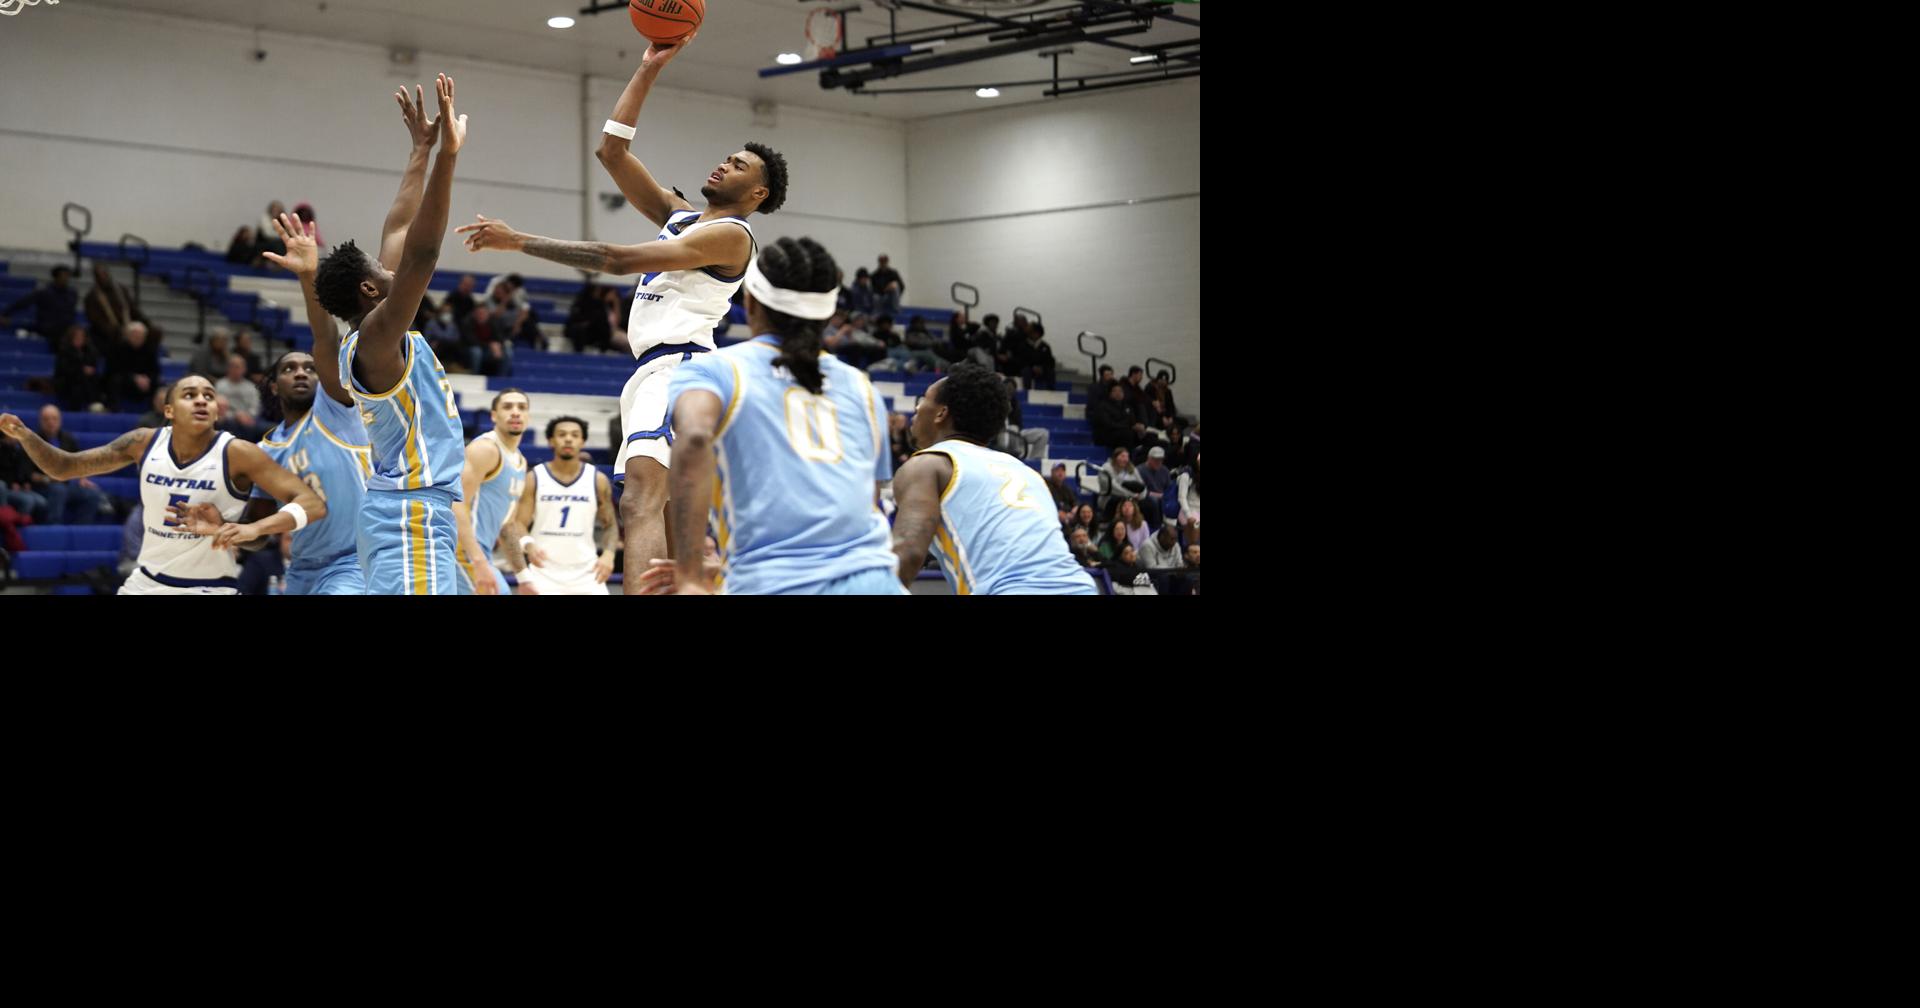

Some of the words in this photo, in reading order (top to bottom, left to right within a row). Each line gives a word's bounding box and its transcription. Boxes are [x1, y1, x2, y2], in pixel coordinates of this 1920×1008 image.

[635, 292, 664, 302] TICUT
[784, 386, 843, 463] 0
[145, 473, 217, 491] CENTRAL
[988, 463, 1041, 511] 2
[560, 505, 571, 528] 1
